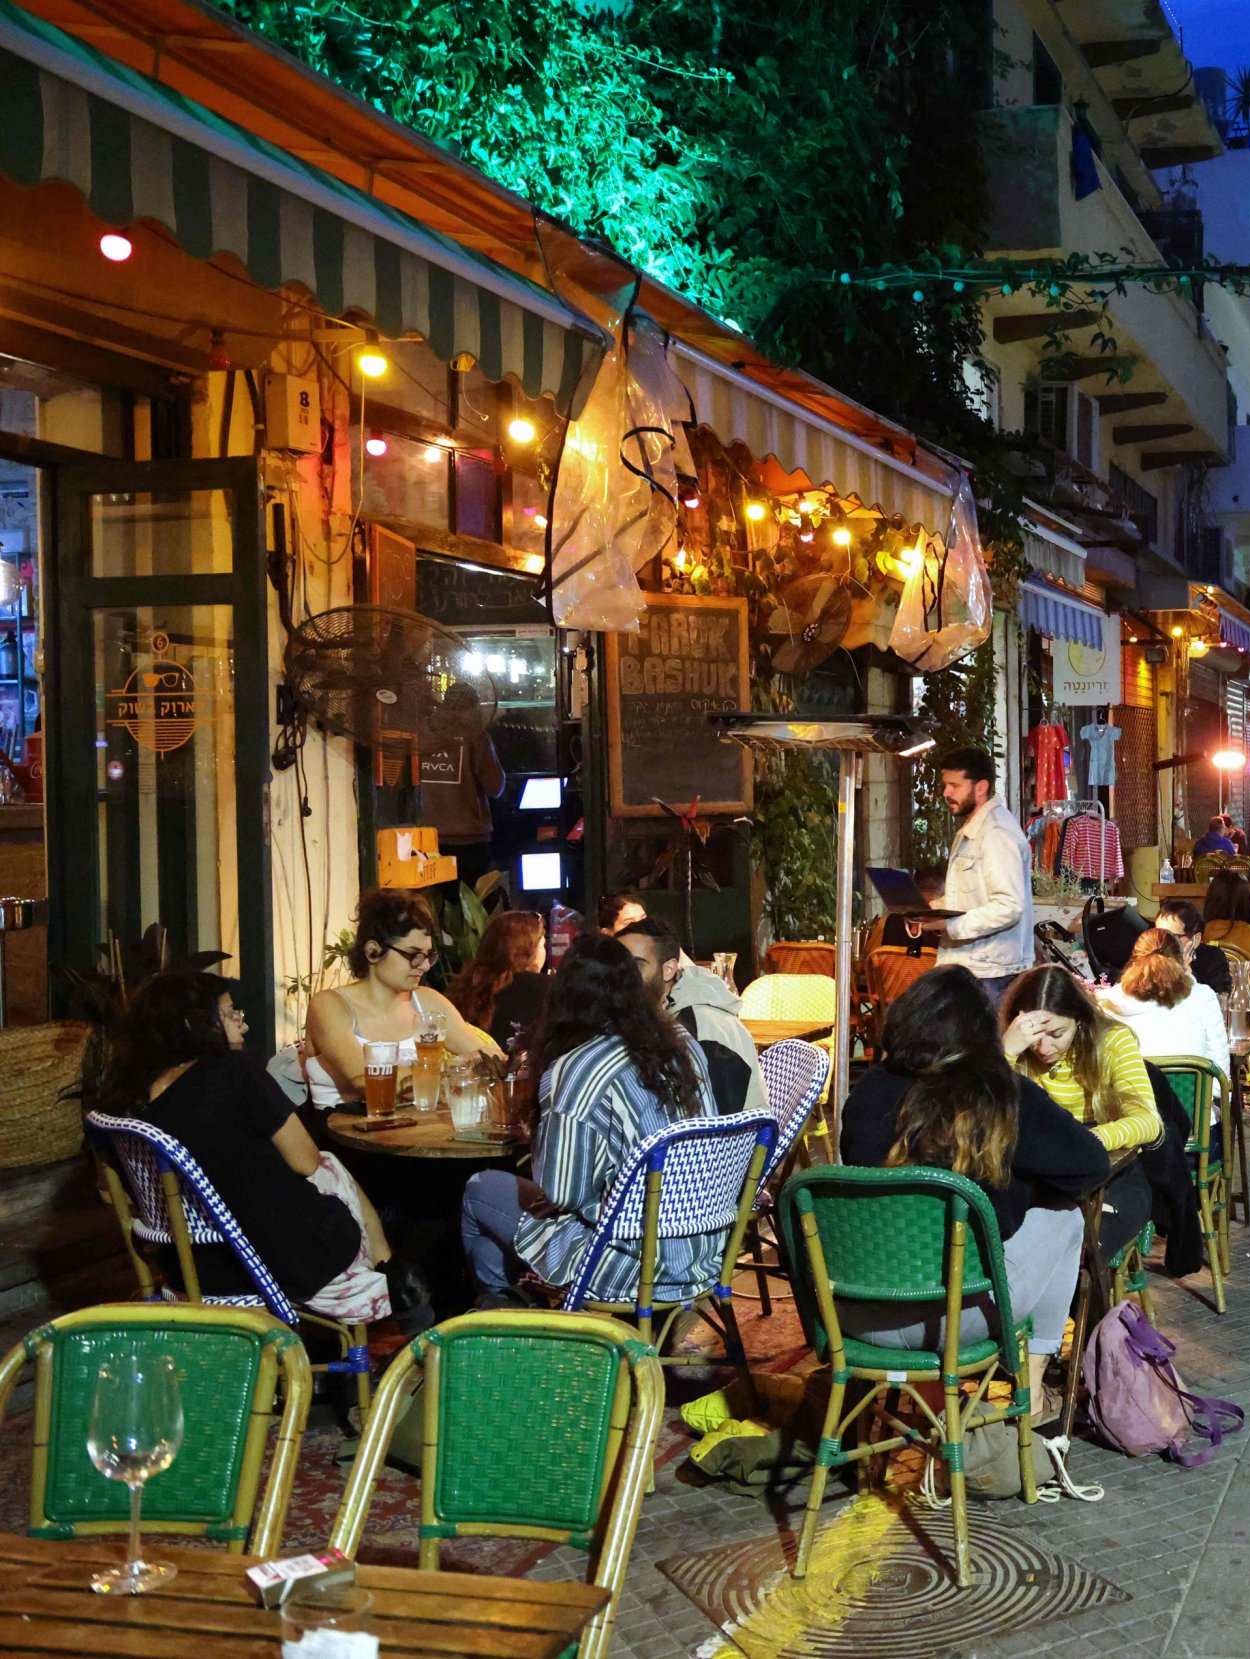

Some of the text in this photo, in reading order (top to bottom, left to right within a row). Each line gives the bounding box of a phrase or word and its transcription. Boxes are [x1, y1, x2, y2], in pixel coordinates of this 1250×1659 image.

[628, 611, 730, 658] FARUK
[620, 656, 737, 698] BASHUK
[161, 701, 205, 716] ארוק
[421, 762, 454, 772] RVCA
